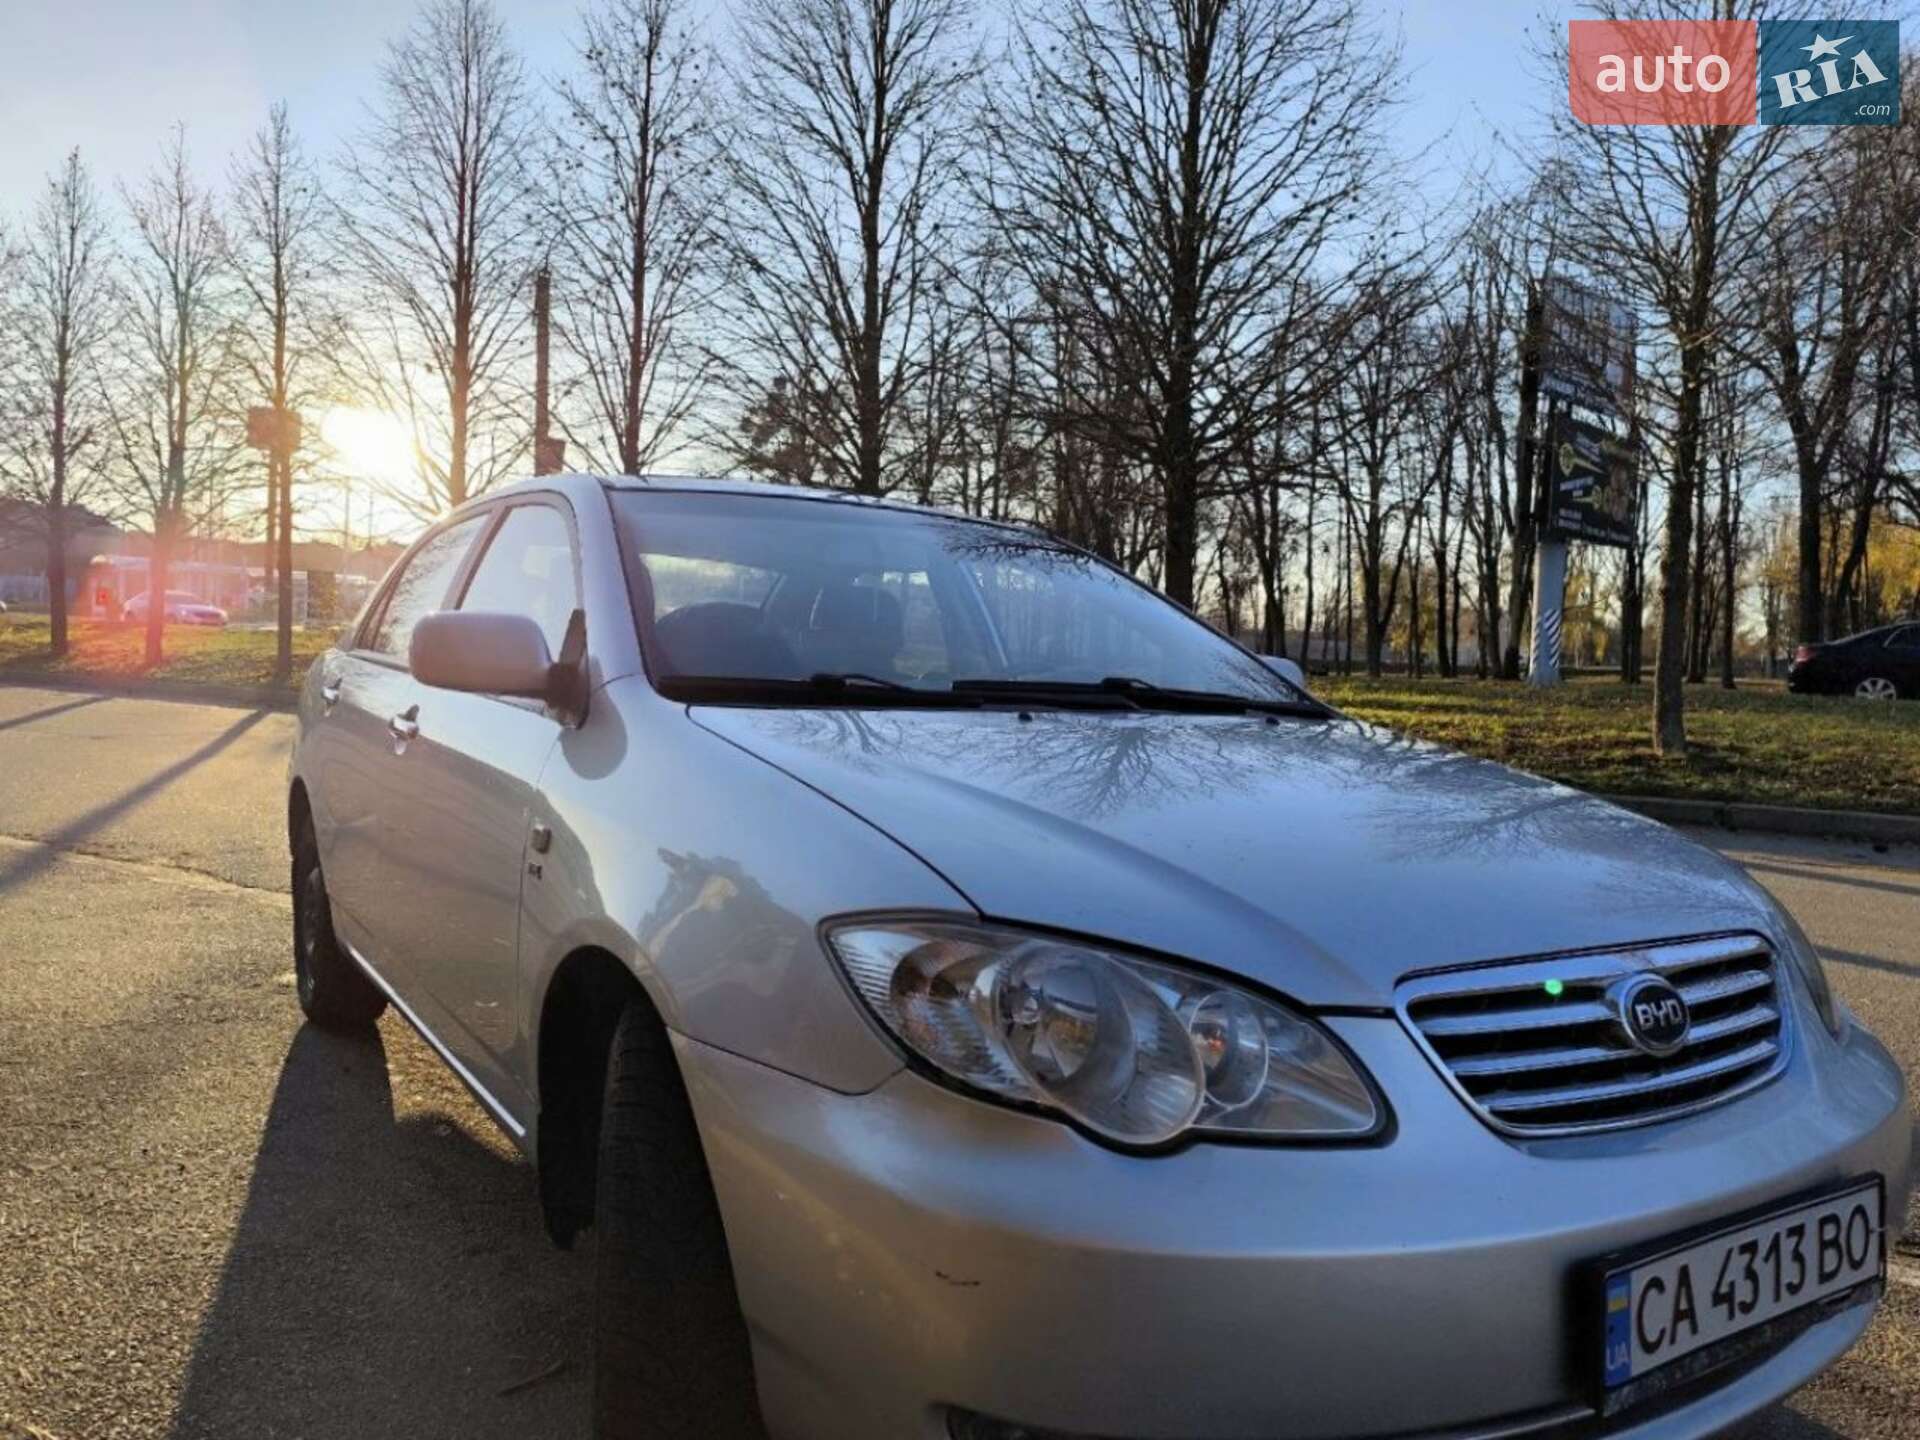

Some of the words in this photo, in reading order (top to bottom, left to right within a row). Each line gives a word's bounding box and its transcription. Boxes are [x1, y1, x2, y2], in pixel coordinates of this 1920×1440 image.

[1635, 998, 1682, 1031] BYD
[1636, 1264, 1698, 1354] CA
[1711, 1223, 1805, 1321] 4313
[1818, 1204, 1871, 1285] BO
[1606, 1341, 1630, 1371] UA
